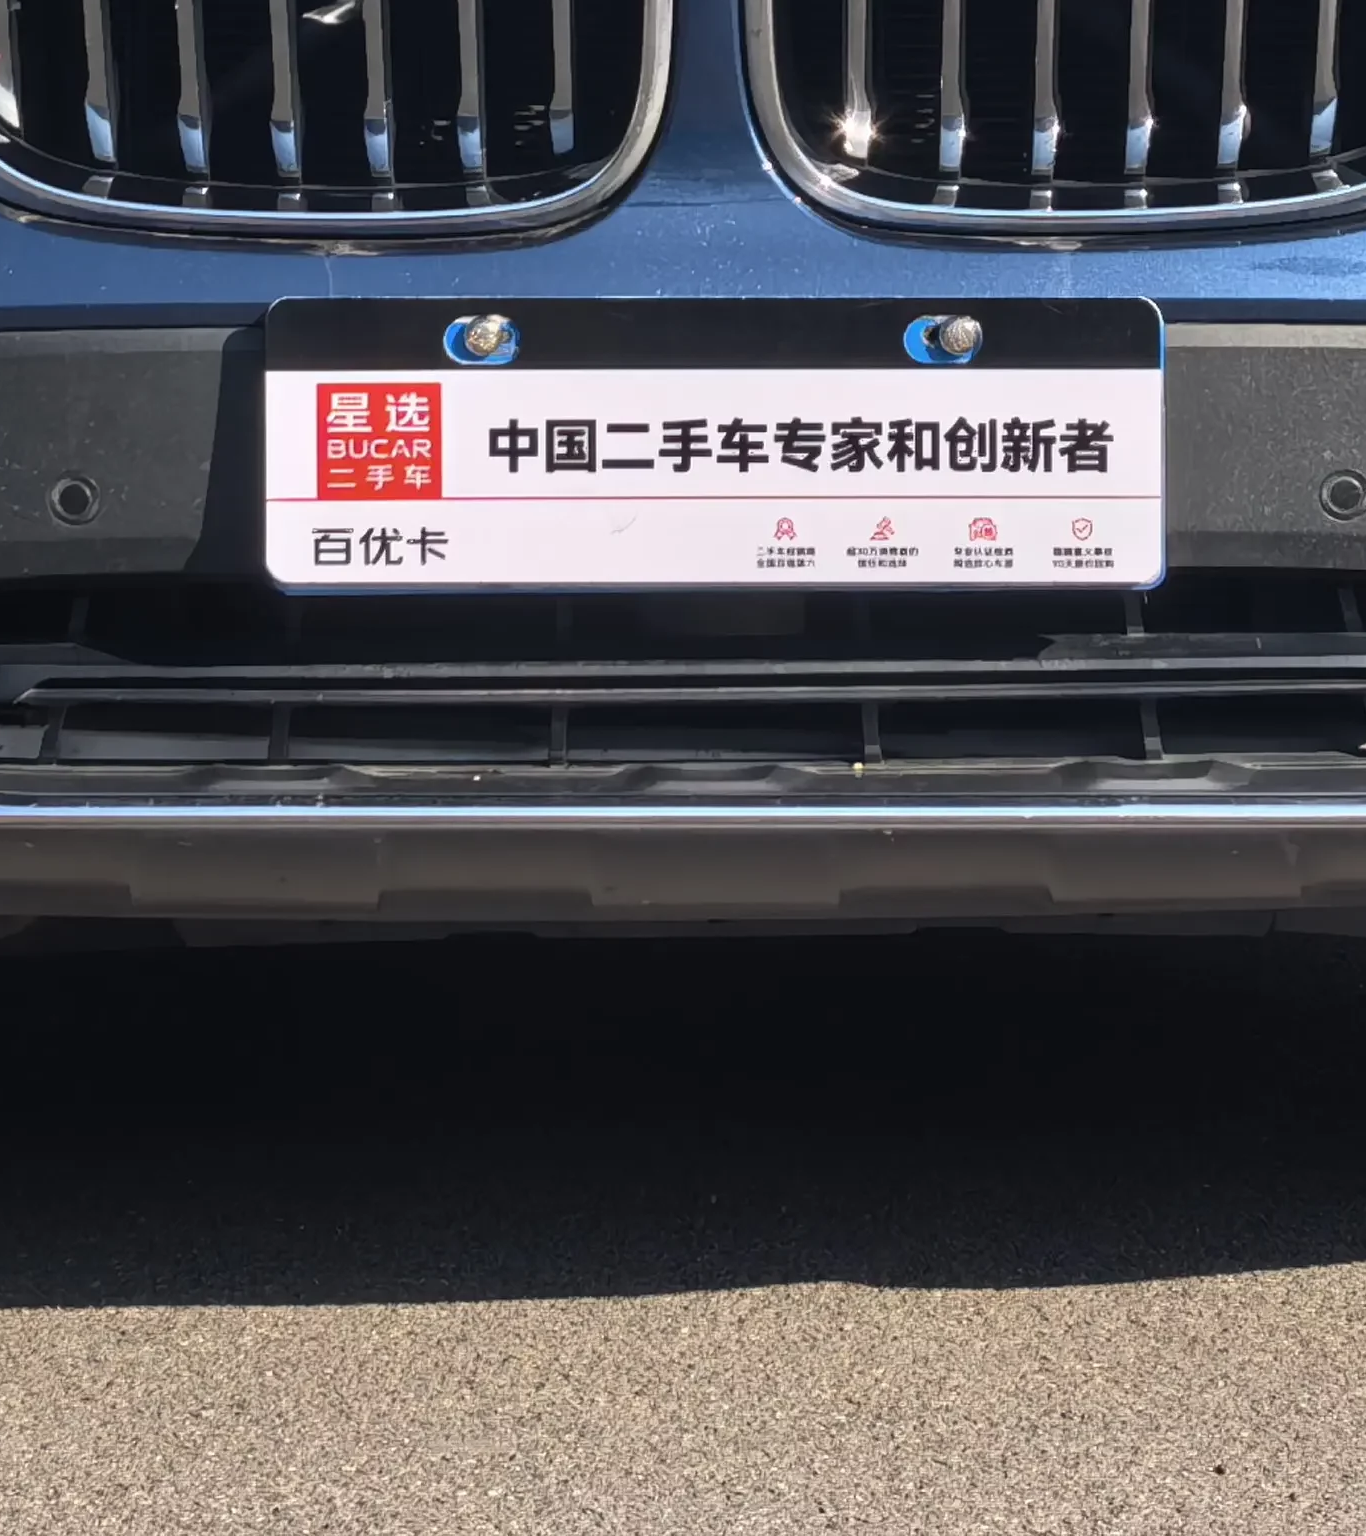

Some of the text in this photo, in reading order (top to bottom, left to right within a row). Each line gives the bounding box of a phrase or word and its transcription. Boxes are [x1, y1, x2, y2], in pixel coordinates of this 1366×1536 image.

[326, 391, 431, 433] 星选
[327, 438, 432, 460] BUCAR
[489, 416, 1114, 474] 中国二手车专家和创新者
[326, 464, 432, 491] 二手车
[311, 526, 449, 566] 百优卡
